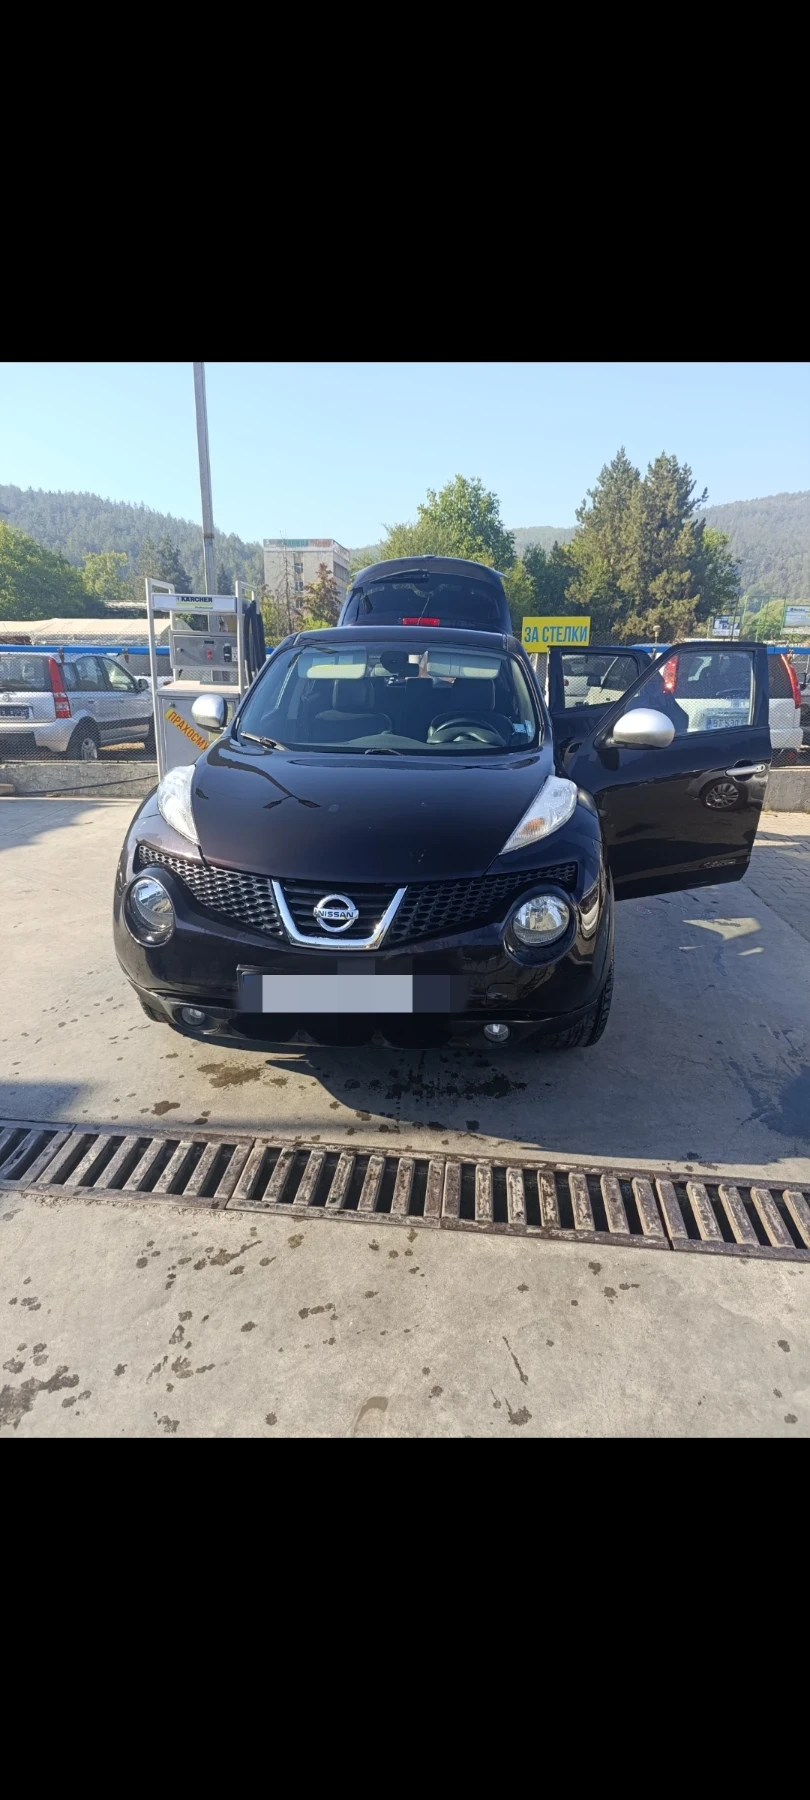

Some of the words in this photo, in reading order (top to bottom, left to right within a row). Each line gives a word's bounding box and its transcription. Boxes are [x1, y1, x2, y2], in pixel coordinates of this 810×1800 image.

[524, 626, 539, 643] ЗА
[542, 625, 588, 643] СТЕЛКИ
[317, 910, 354, 918] NISSAN
